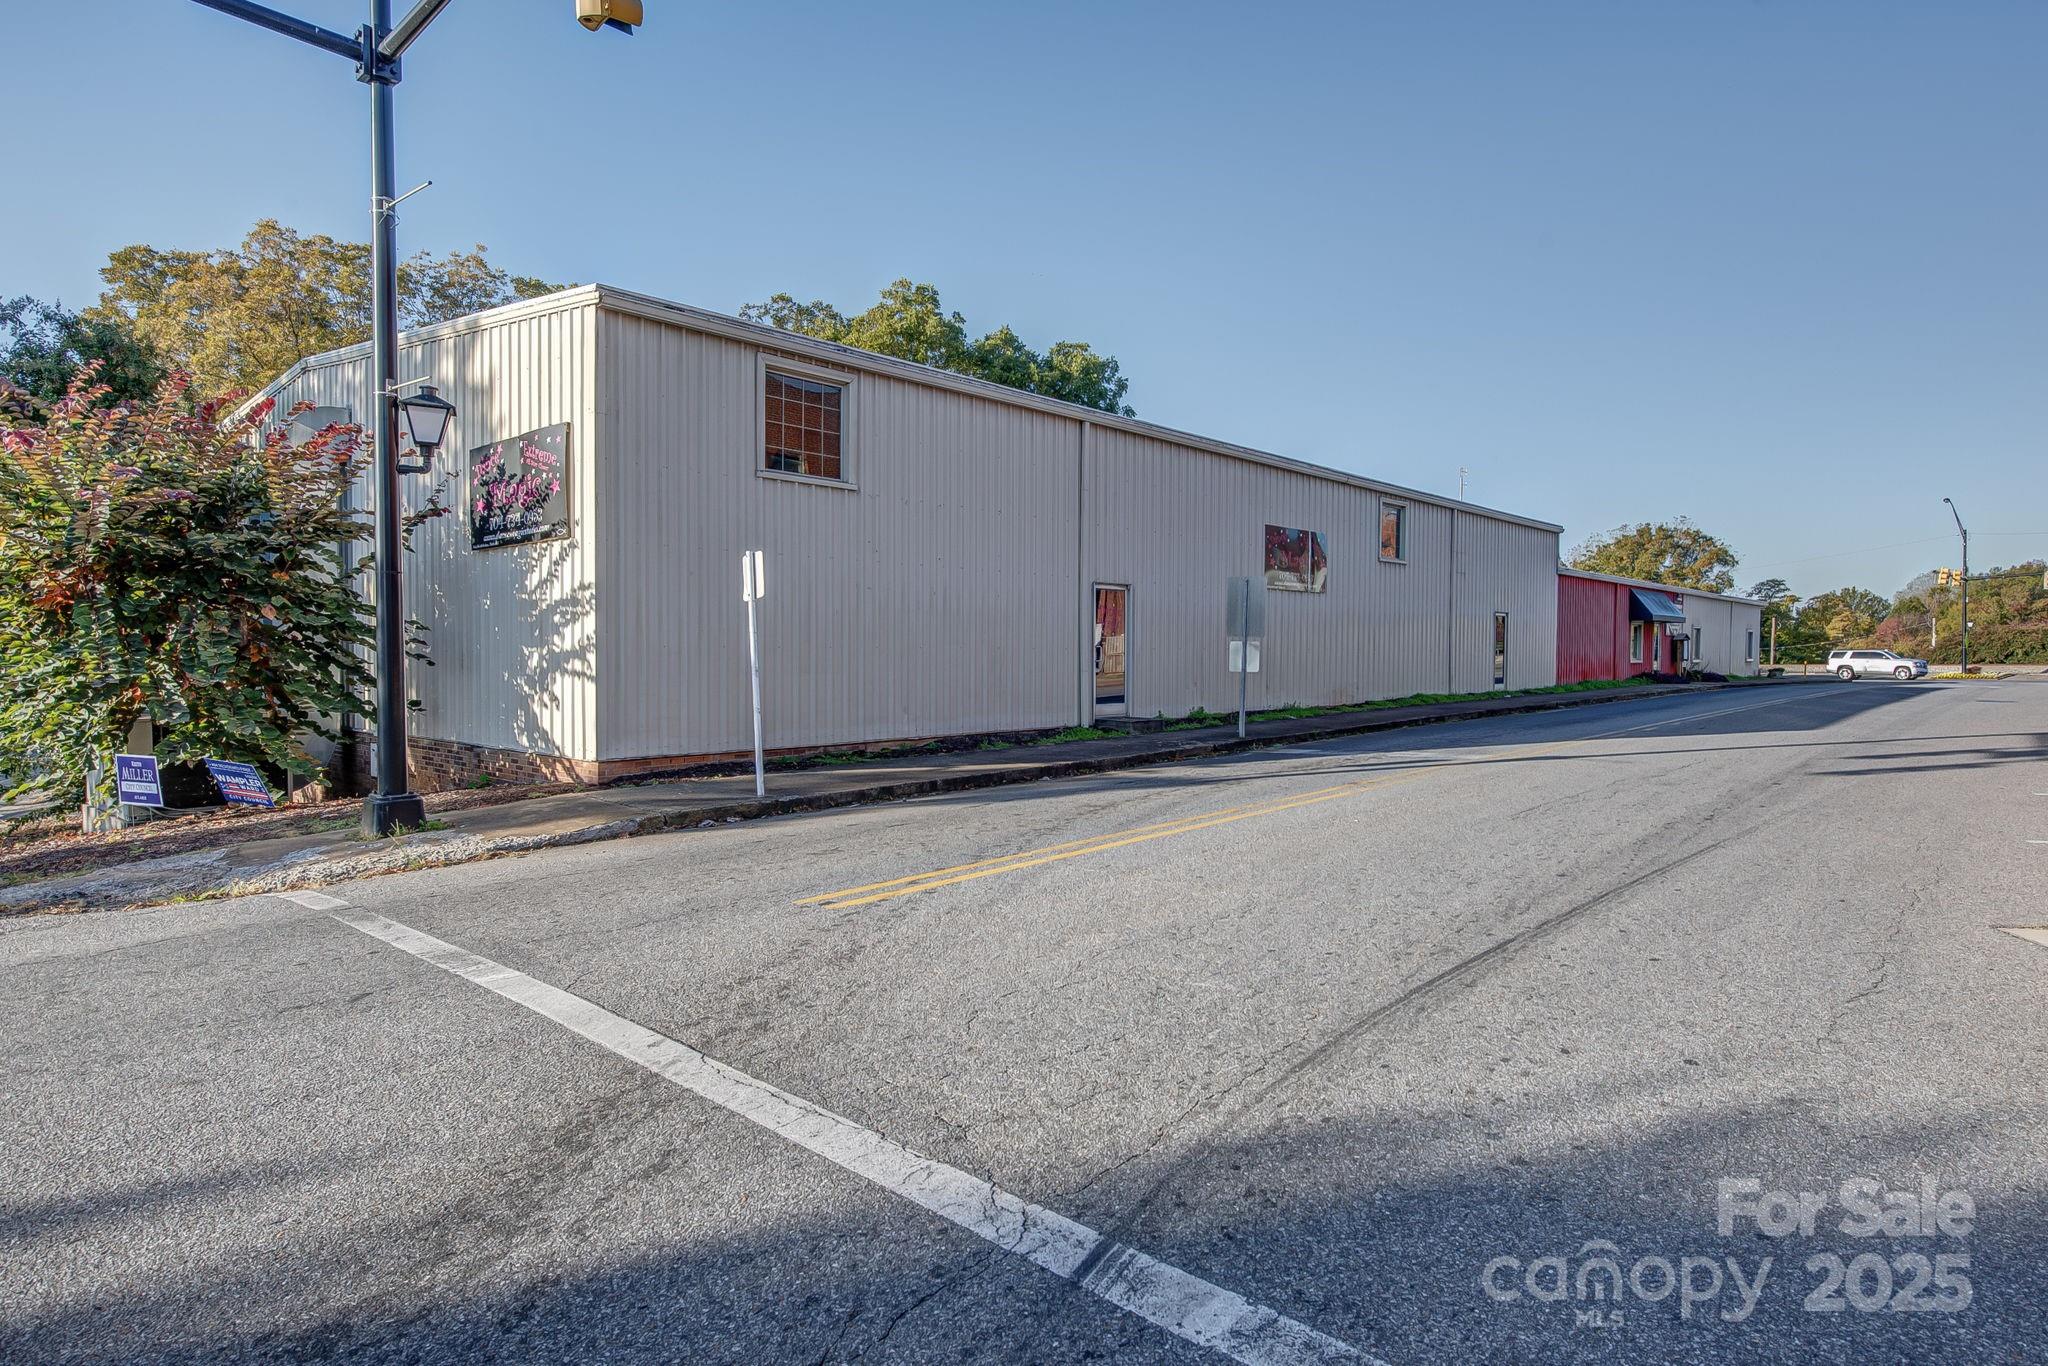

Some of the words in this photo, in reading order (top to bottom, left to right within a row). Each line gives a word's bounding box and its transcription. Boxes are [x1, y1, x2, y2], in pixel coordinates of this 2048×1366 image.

[523, 440, 557, 465] Extreme
[489, 474, 541, 508] Magic
[121, 766, 155, 782] MILLER
[214, 774, 262, 788] WAMPLER
[243, 796, 269, 804] COUNCIL
